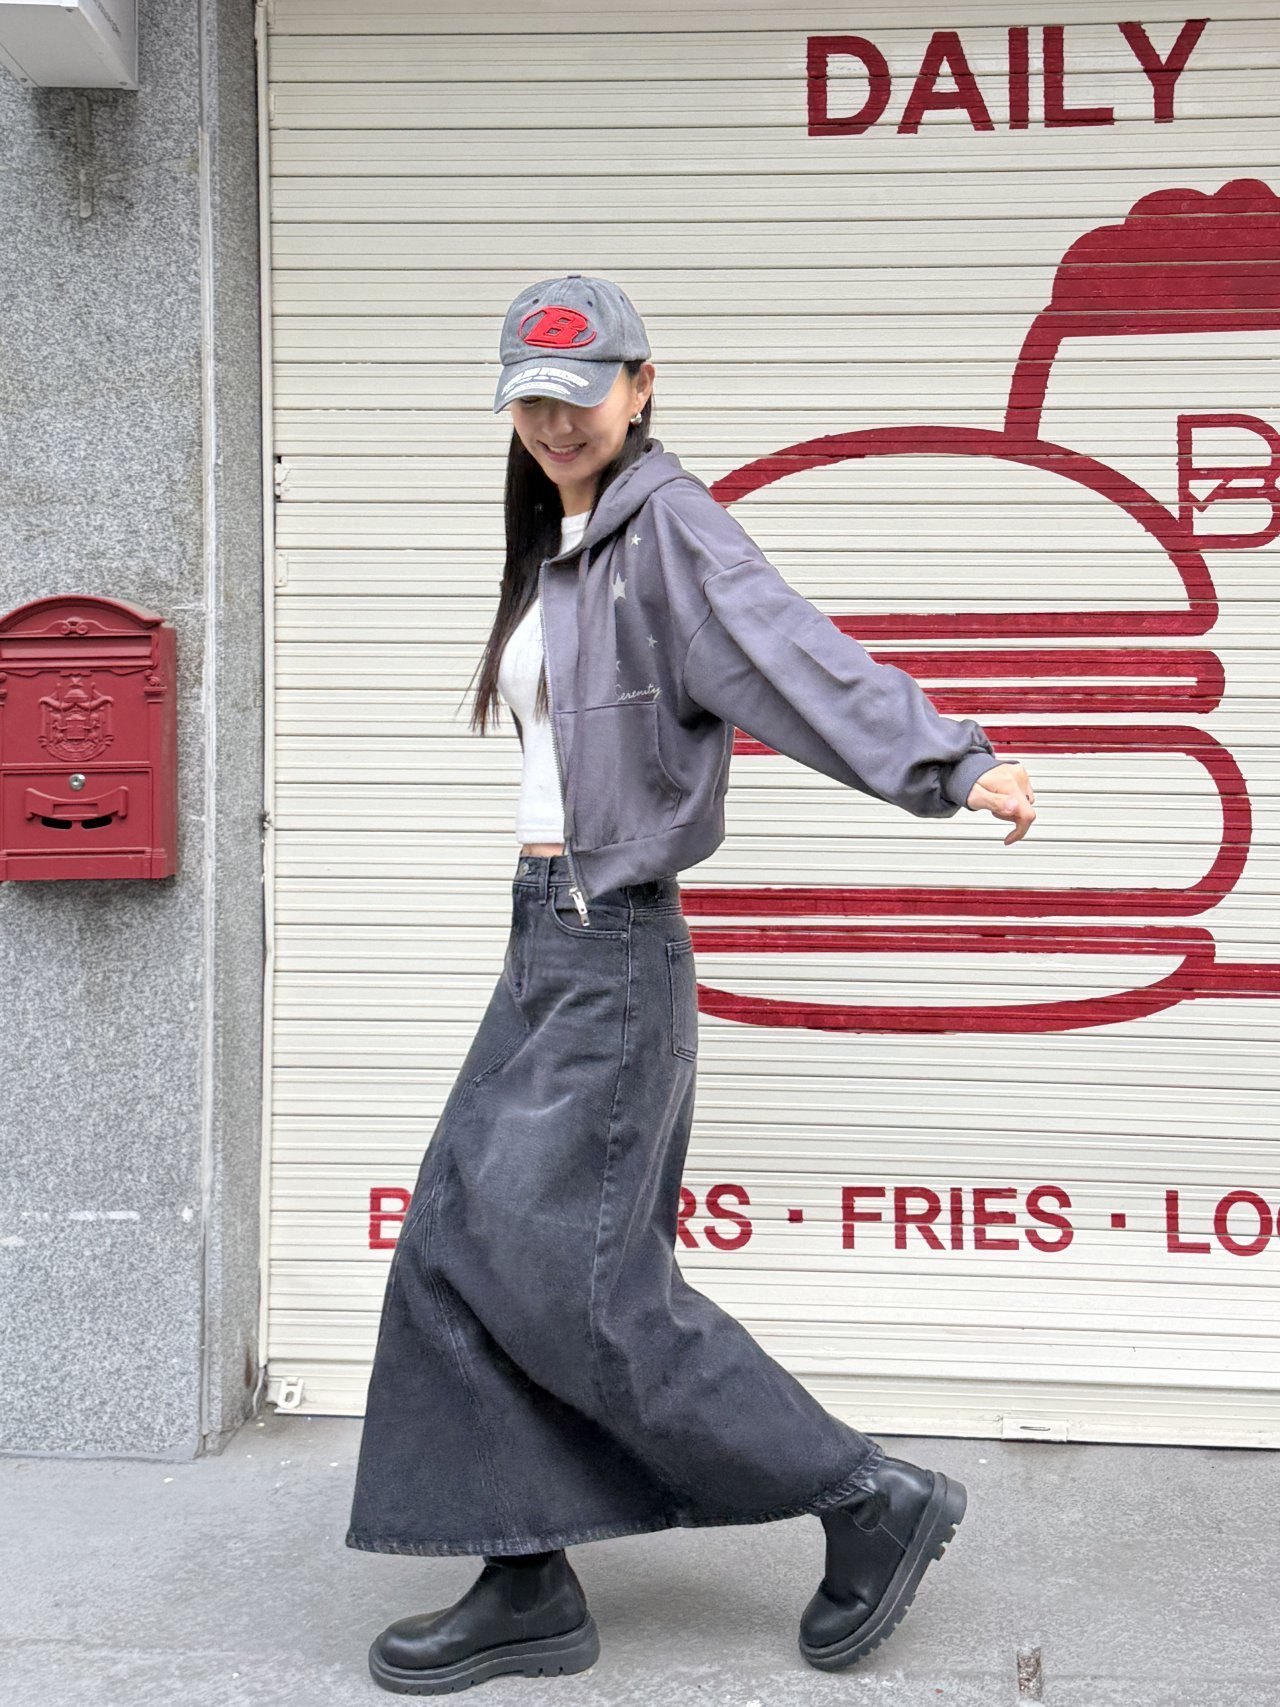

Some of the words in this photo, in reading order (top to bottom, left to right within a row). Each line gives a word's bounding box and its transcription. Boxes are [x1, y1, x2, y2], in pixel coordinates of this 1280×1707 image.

[807, 18, 1211, 136] DAILY
[841, 1185, 1074, 1252] FRIES
[1165, 1189, 1280, 1257] LO
